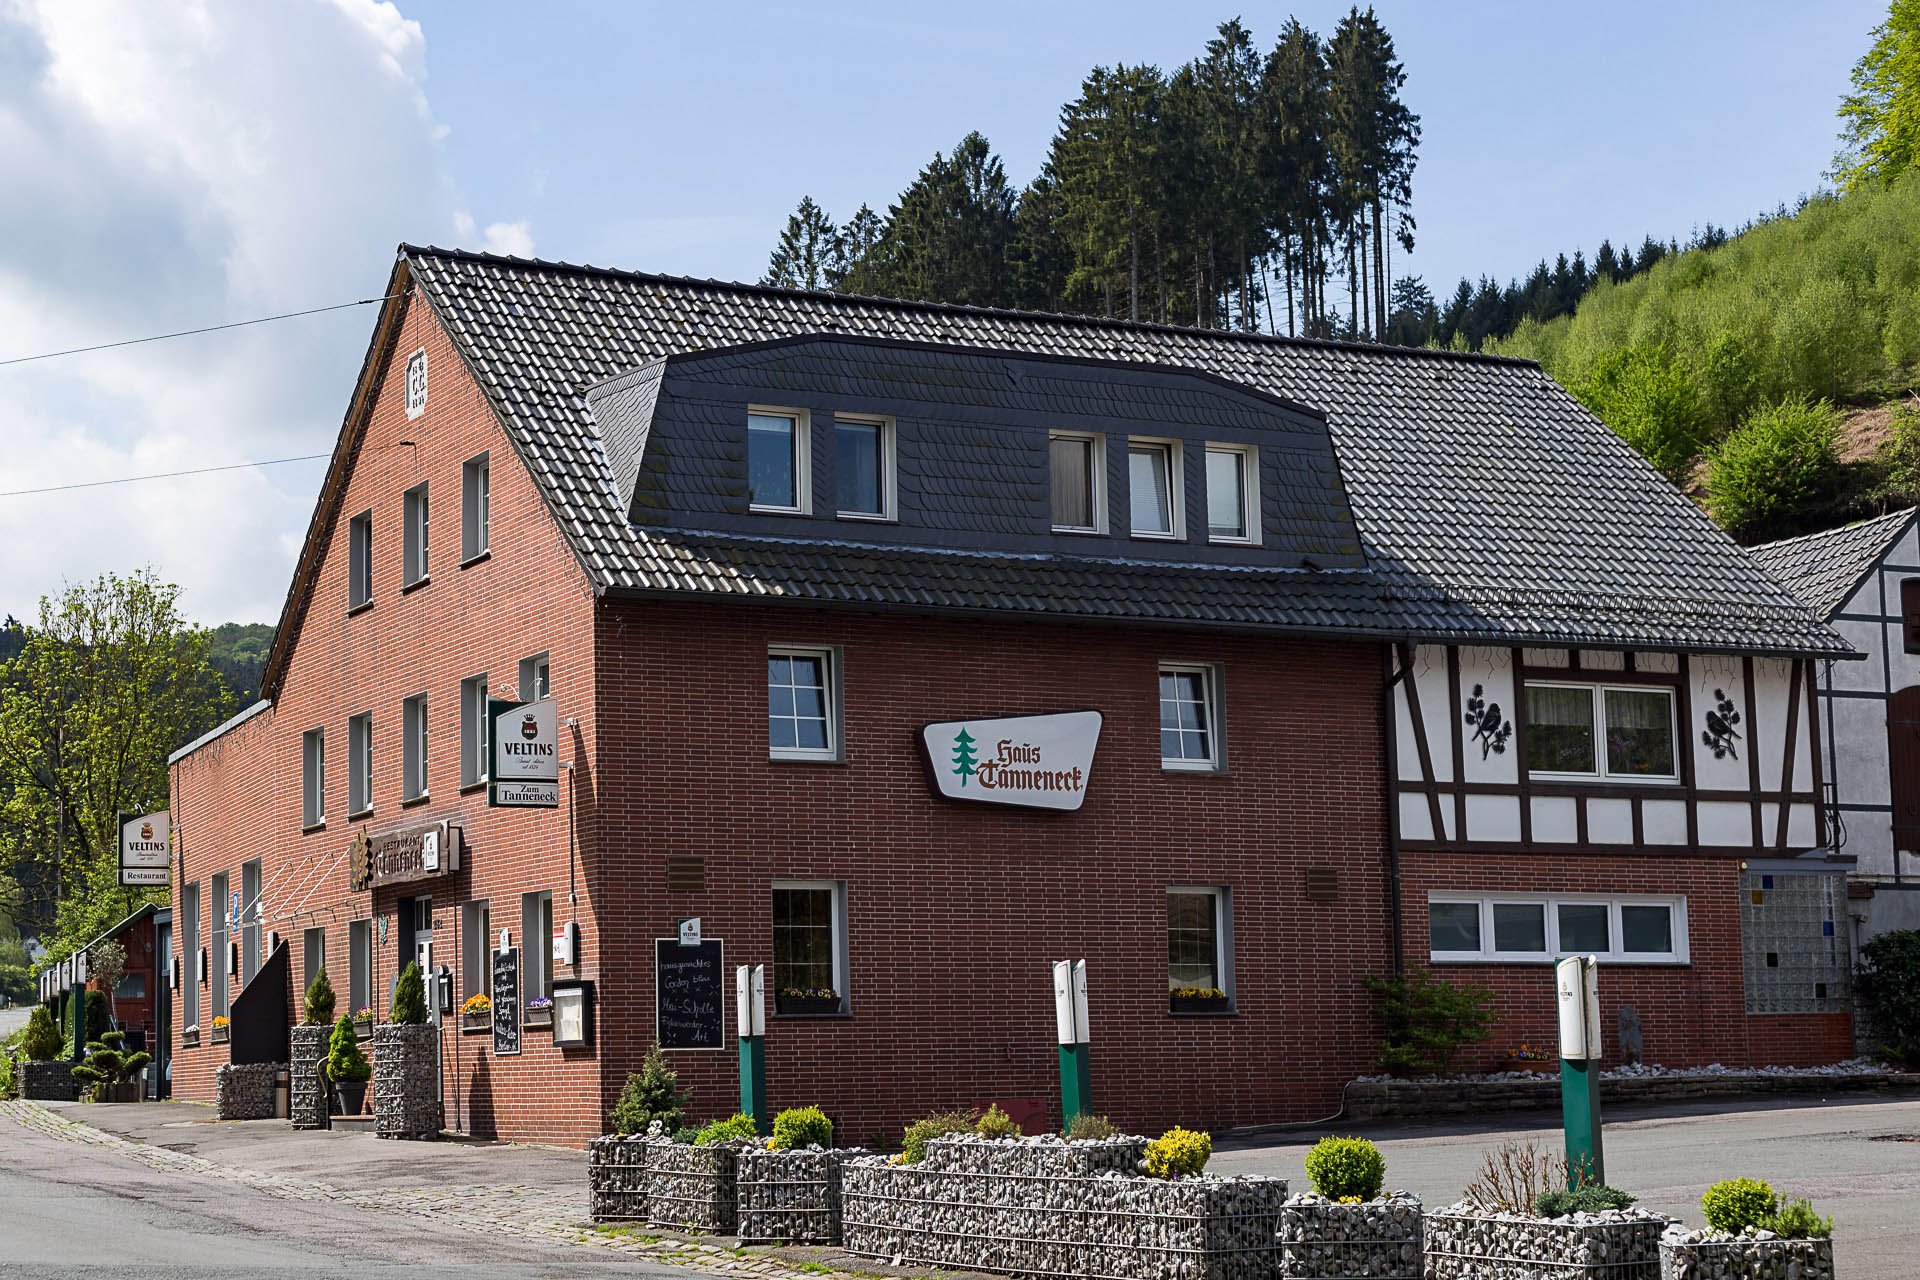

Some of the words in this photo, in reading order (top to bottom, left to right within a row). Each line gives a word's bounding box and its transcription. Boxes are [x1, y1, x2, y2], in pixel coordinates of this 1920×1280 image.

[504, 742, 553, 756] VELTINS
[997, 738, 1041, 767] Haus
[975, 759, 1084, 792] Tanneneck
[520, 784, 540, 793] Zum
[502, 790, 556, 802] Tanneneck
[128, 842, 165, 851] VELTINS
[383, 835, 420, 851] RESTAURANT
[127, 872, 167, 880] Restaurant
[664, 975, 690, 989] Cordon
